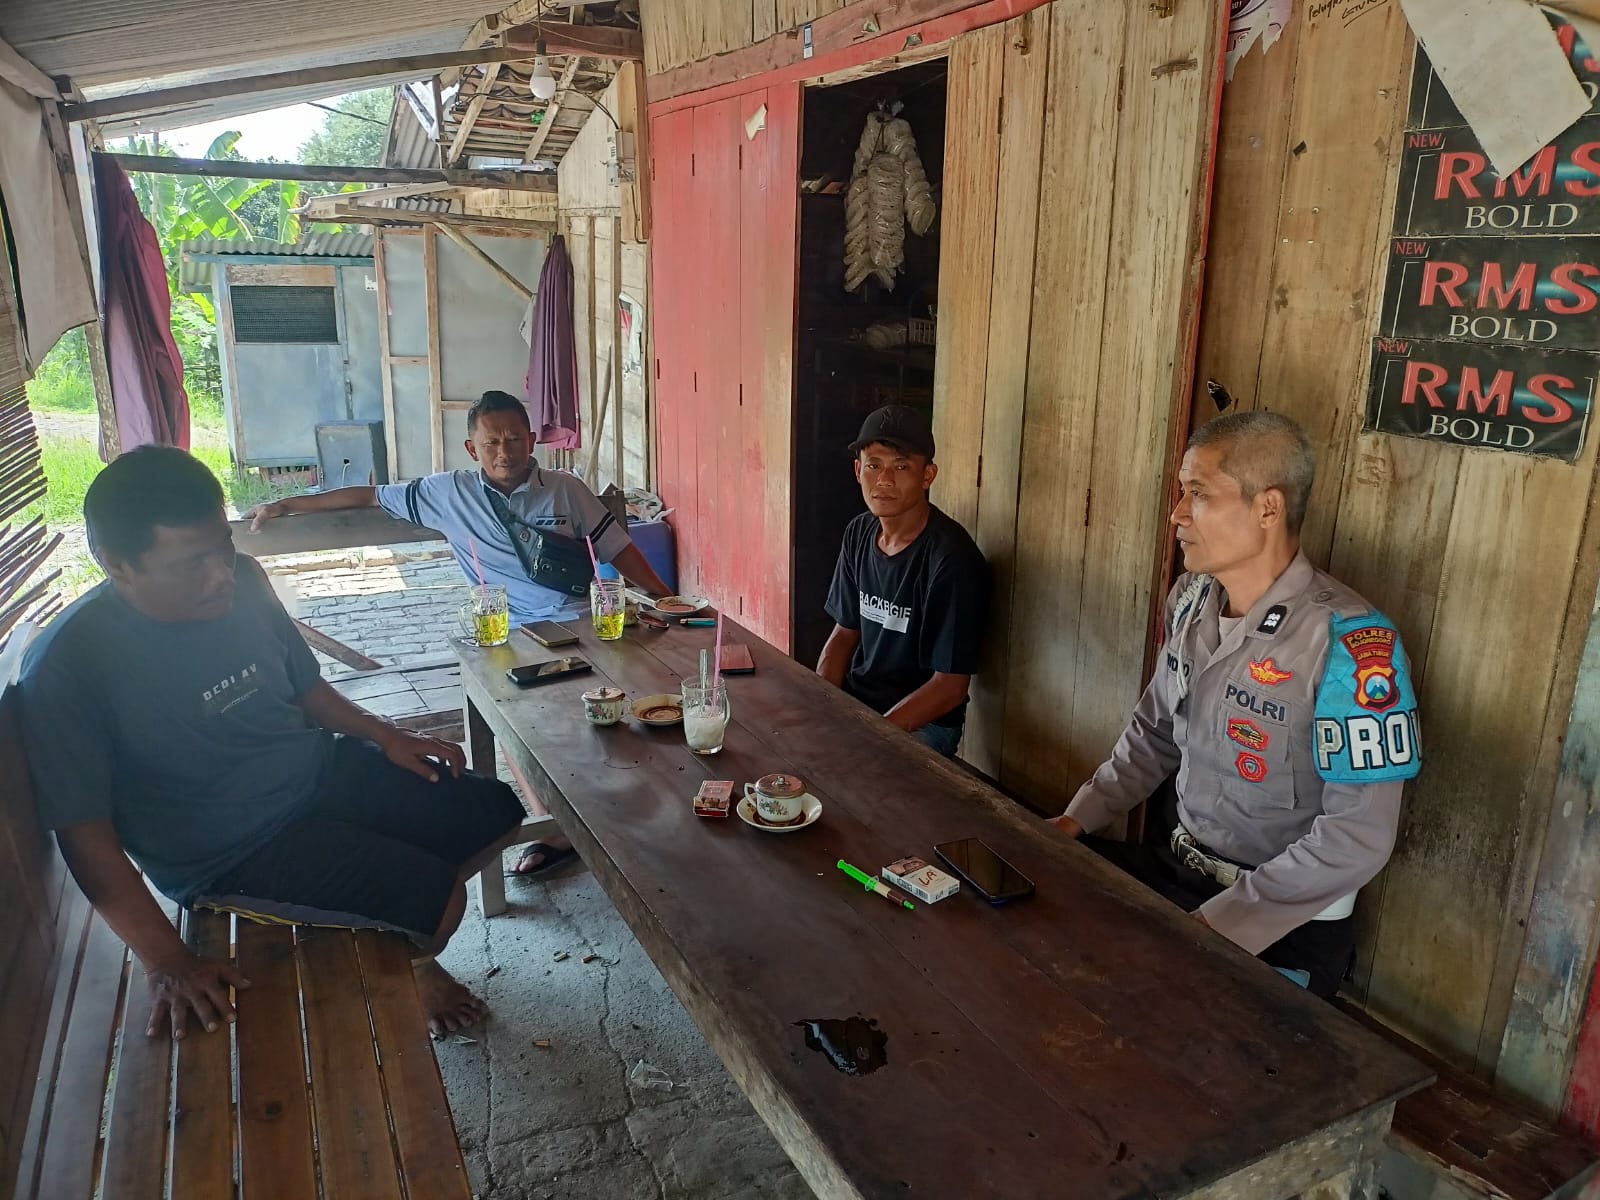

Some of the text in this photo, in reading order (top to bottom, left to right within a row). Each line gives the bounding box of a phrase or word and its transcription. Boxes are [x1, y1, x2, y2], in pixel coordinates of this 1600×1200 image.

[1409, 133, 1443, 148] NEW
[1434, 141, 1600, 200] RMS
[1464, 203, 1578, 229] BOLD
[1395, 241, 1427, 255] NEW
[1419, 260, 1600, 315] RMS
[1448, 314, 1558, 343] BOLD
[1377, 340, 1409, 354] NEW
[1401, 360, 1575, 424] RMS
[1429, 414, 1535, 448] BOLD
[1346, 629, 1393, 645] POLRES
[1225, 683, 1286, 722] POLRI
[918, 869, 937, 886] LA
